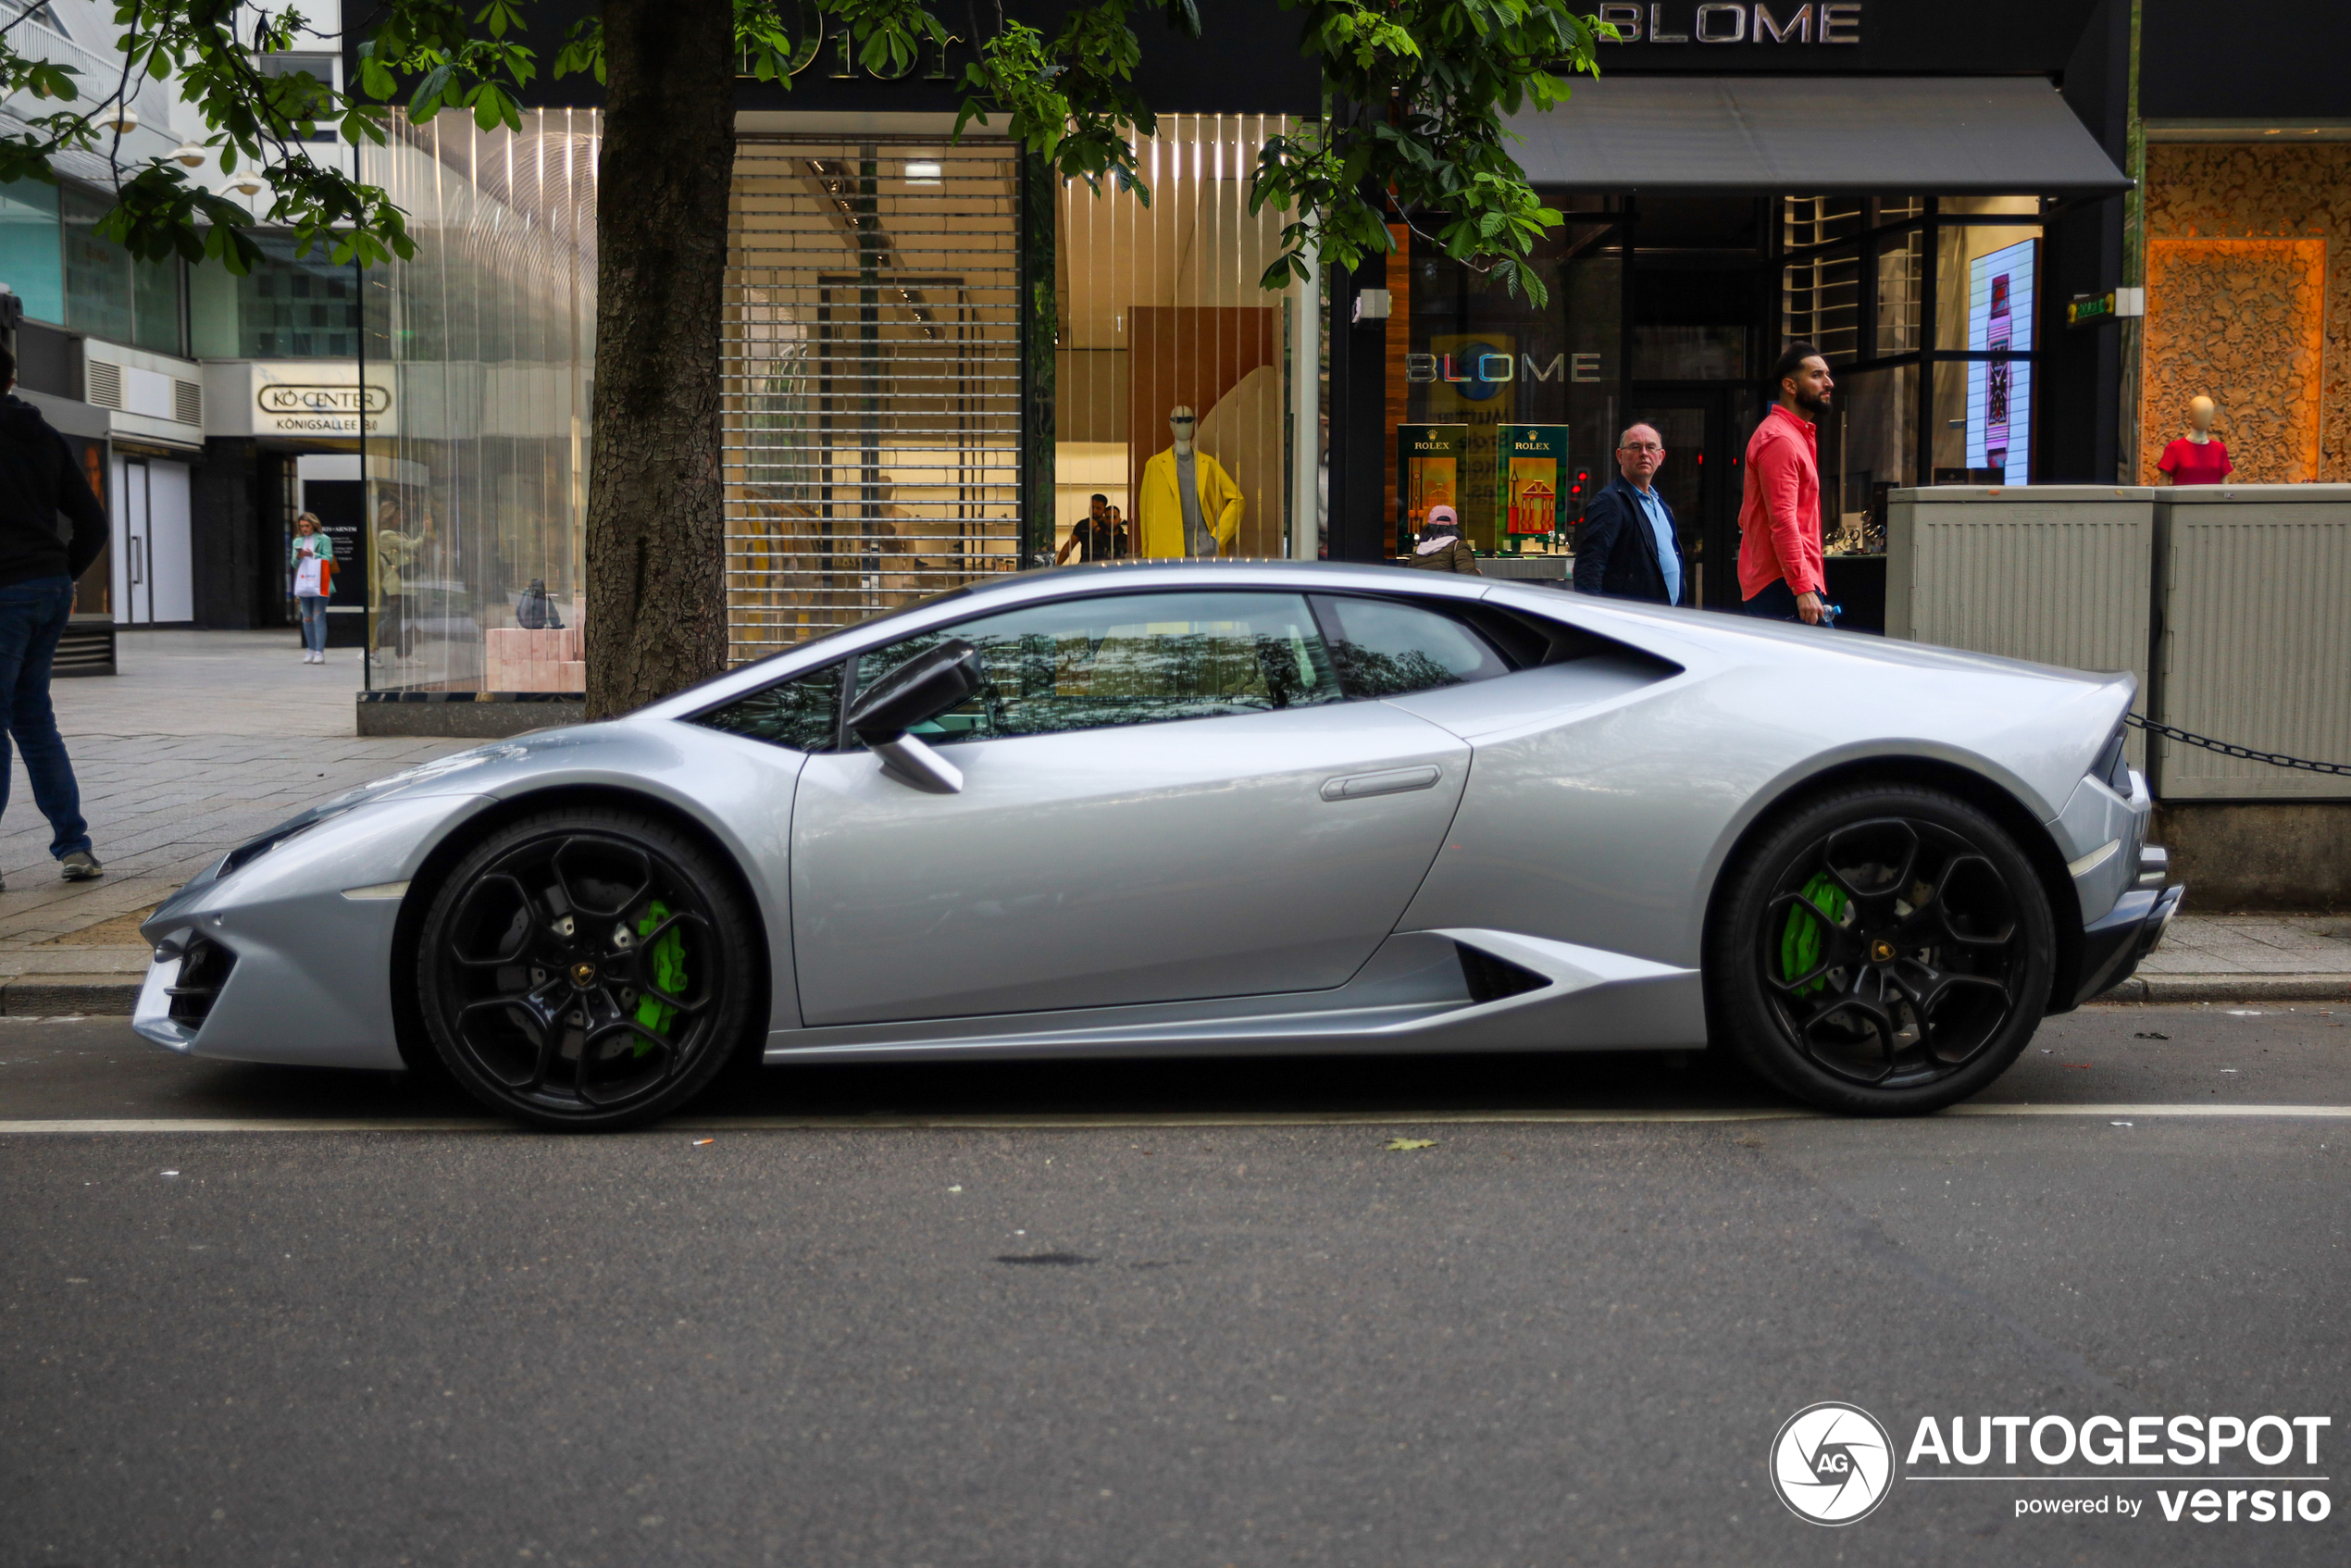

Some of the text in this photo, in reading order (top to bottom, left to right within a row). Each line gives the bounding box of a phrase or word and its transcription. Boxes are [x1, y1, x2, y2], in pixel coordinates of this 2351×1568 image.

[1598, 3, 1861, 44] BLOME
[1406, 353, 1601, 382] BLOME
[277, 417, 358, 430] KÖNIGSALLEE
[1414, 442, 1450, 450] ROLEX
[1514, 442, 1550, 451] ROLEX
